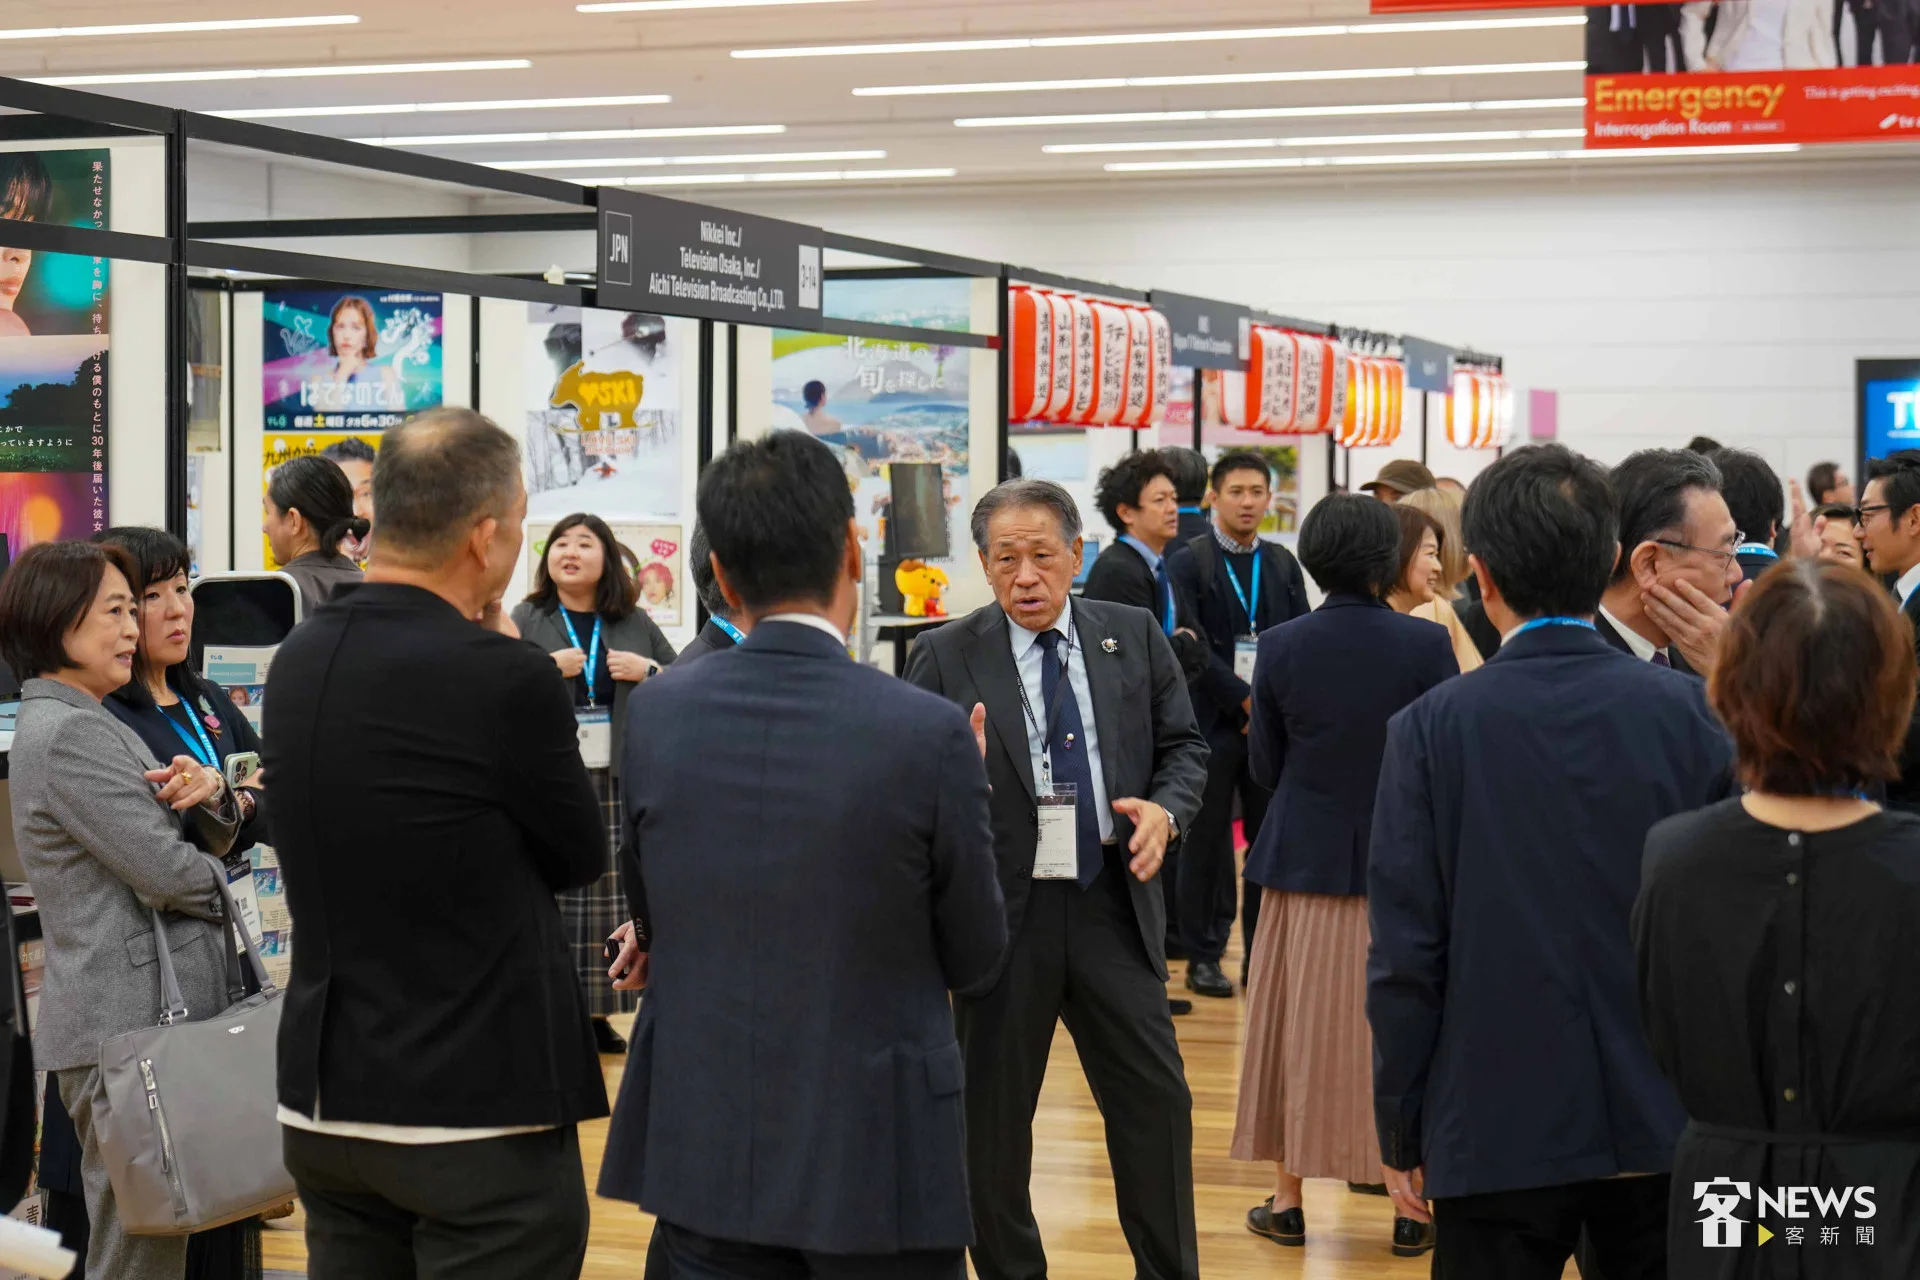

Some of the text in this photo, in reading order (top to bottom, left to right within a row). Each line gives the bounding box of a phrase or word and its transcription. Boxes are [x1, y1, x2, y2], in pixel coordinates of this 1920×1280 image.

[1595, 78, 1785, 118] Emergency
[1594, 119, 1686, 140] Interrogation
[1688, 117, 1732, 134] Room
[609, 233, 628, 264] JPN
[700, 220, 742, 248] Nikkei Inc./
[680, 247, 718, 272] Television
[718, 252, 743, 281] Osaka,
[649, 272, 670, 296] Aichi
[671, 275, 710, 300] Television
[710, 280, 757, 312] Broadcasting
[598, 379, 636, 407] SKI
